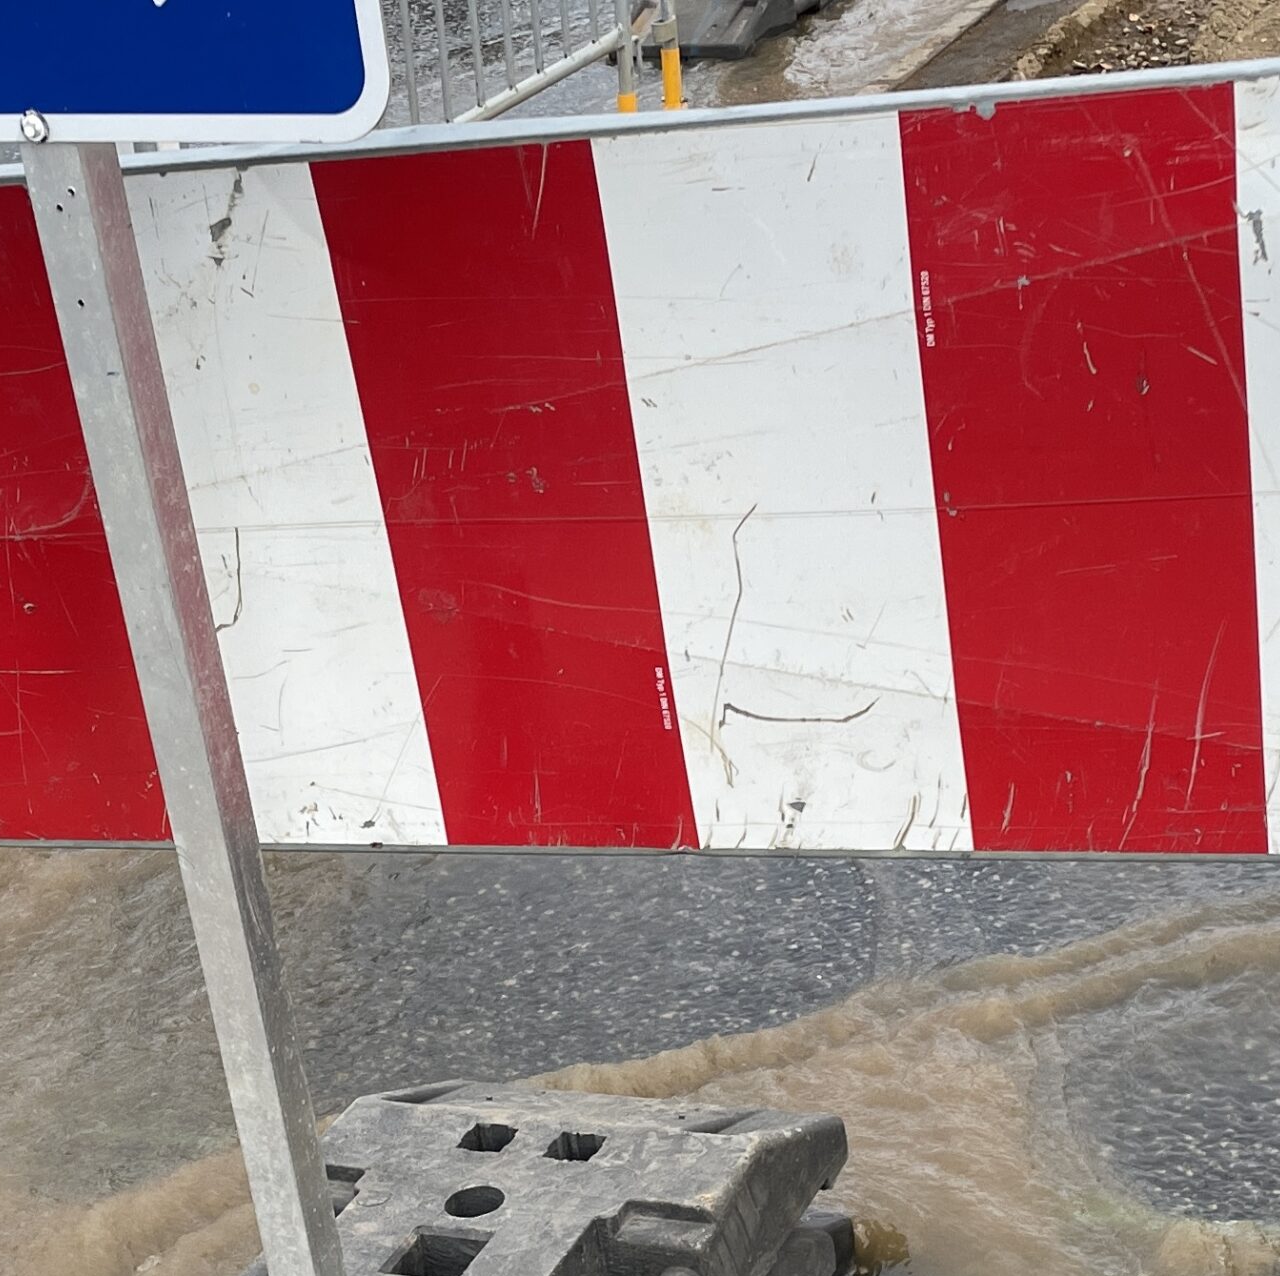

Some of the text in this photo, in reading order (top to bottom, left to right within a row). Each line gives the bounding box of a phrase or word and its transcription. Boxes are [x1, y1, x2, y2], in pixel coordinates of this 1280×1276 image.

[922, 296, 932, 311] DIN
[925, 317, 936, 333] Typ
[655, 679, 665, 692] Typ
